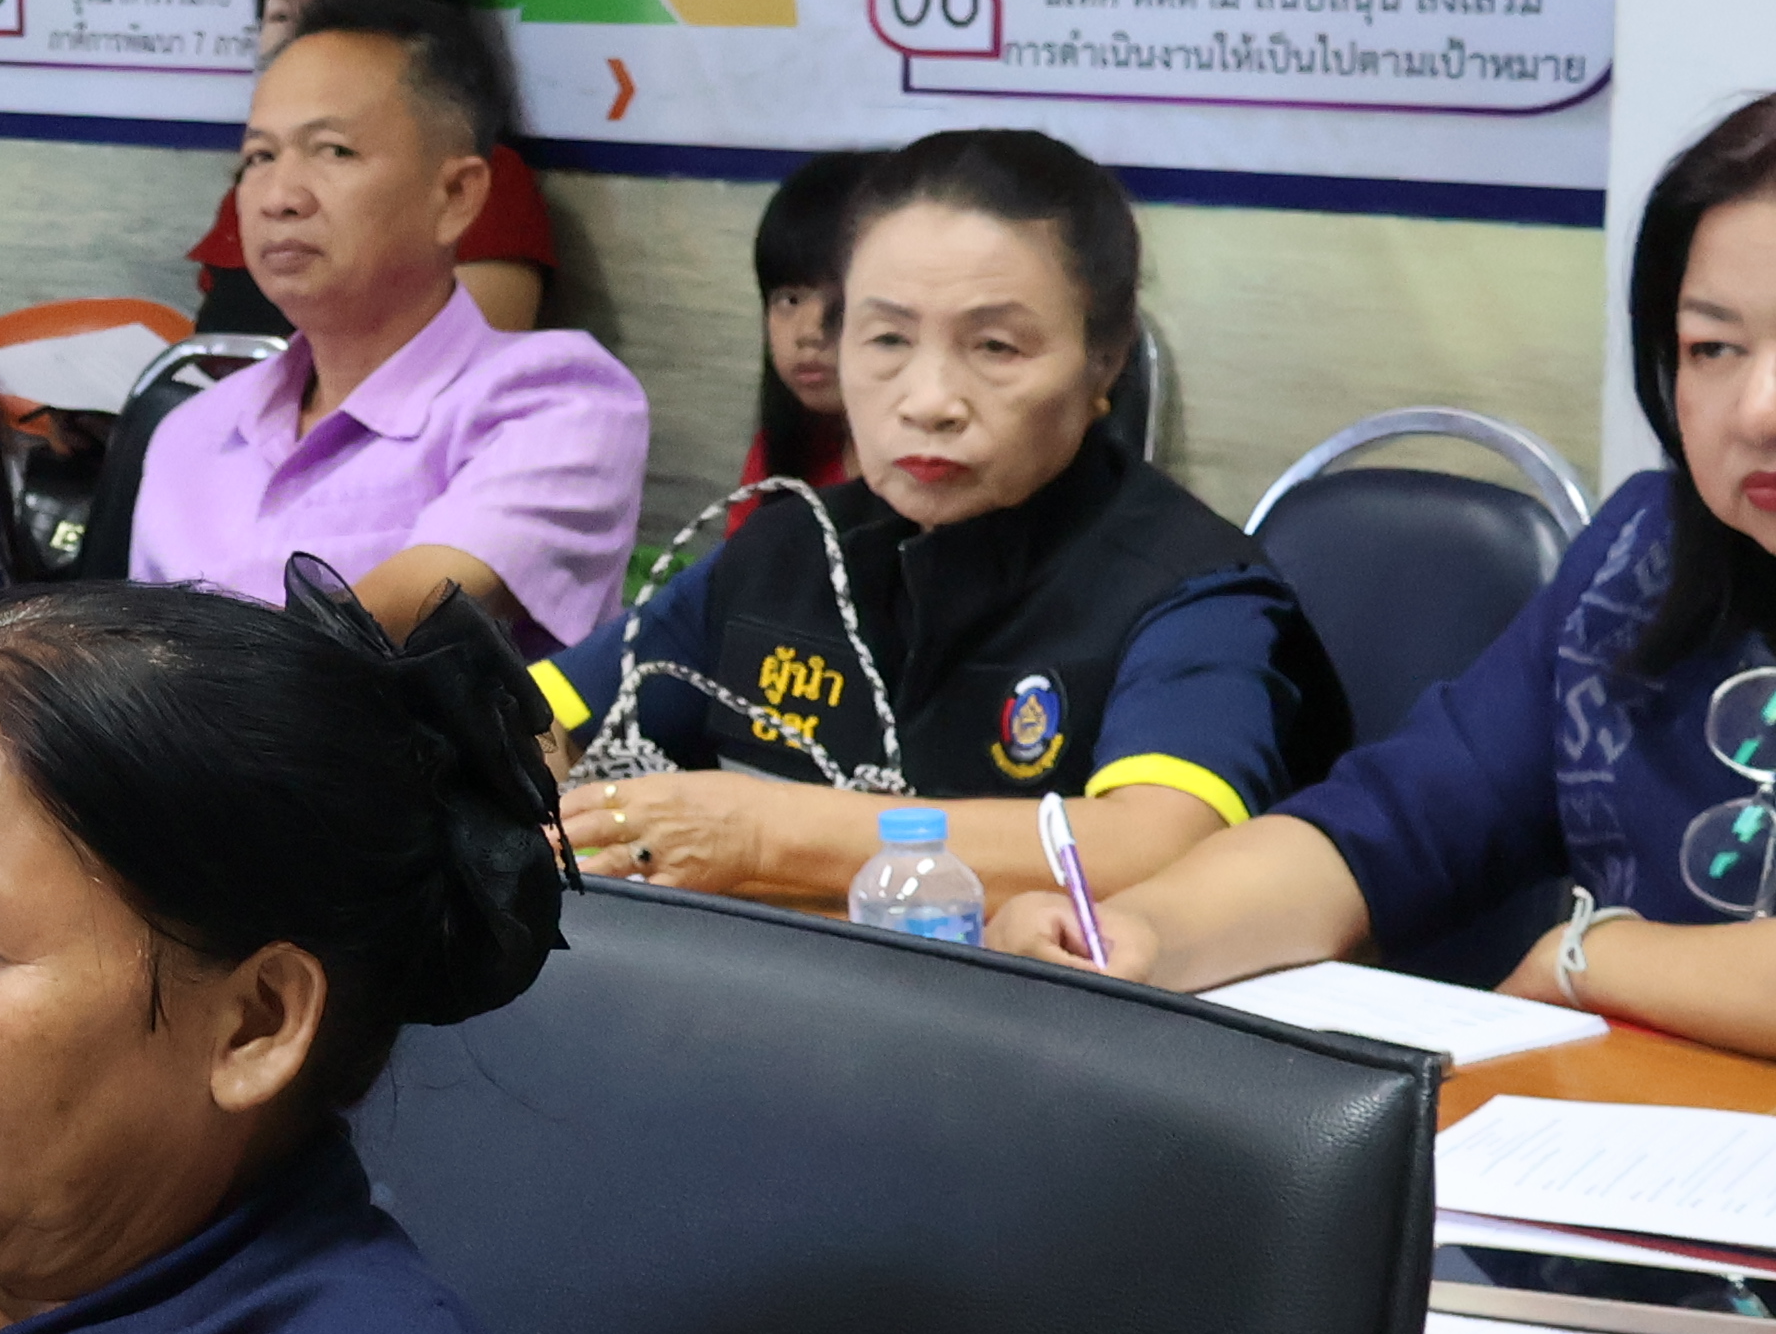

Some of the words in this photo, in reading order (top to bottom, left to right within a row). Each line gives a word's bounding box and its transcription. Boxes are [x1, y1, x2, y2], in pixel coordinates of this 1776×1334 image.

[1001, 32, 1588, 86] การดำเนินงานให้เป็นไปตามเป้าหมาย
[758, 645, 845, 707] ผู้นำ
